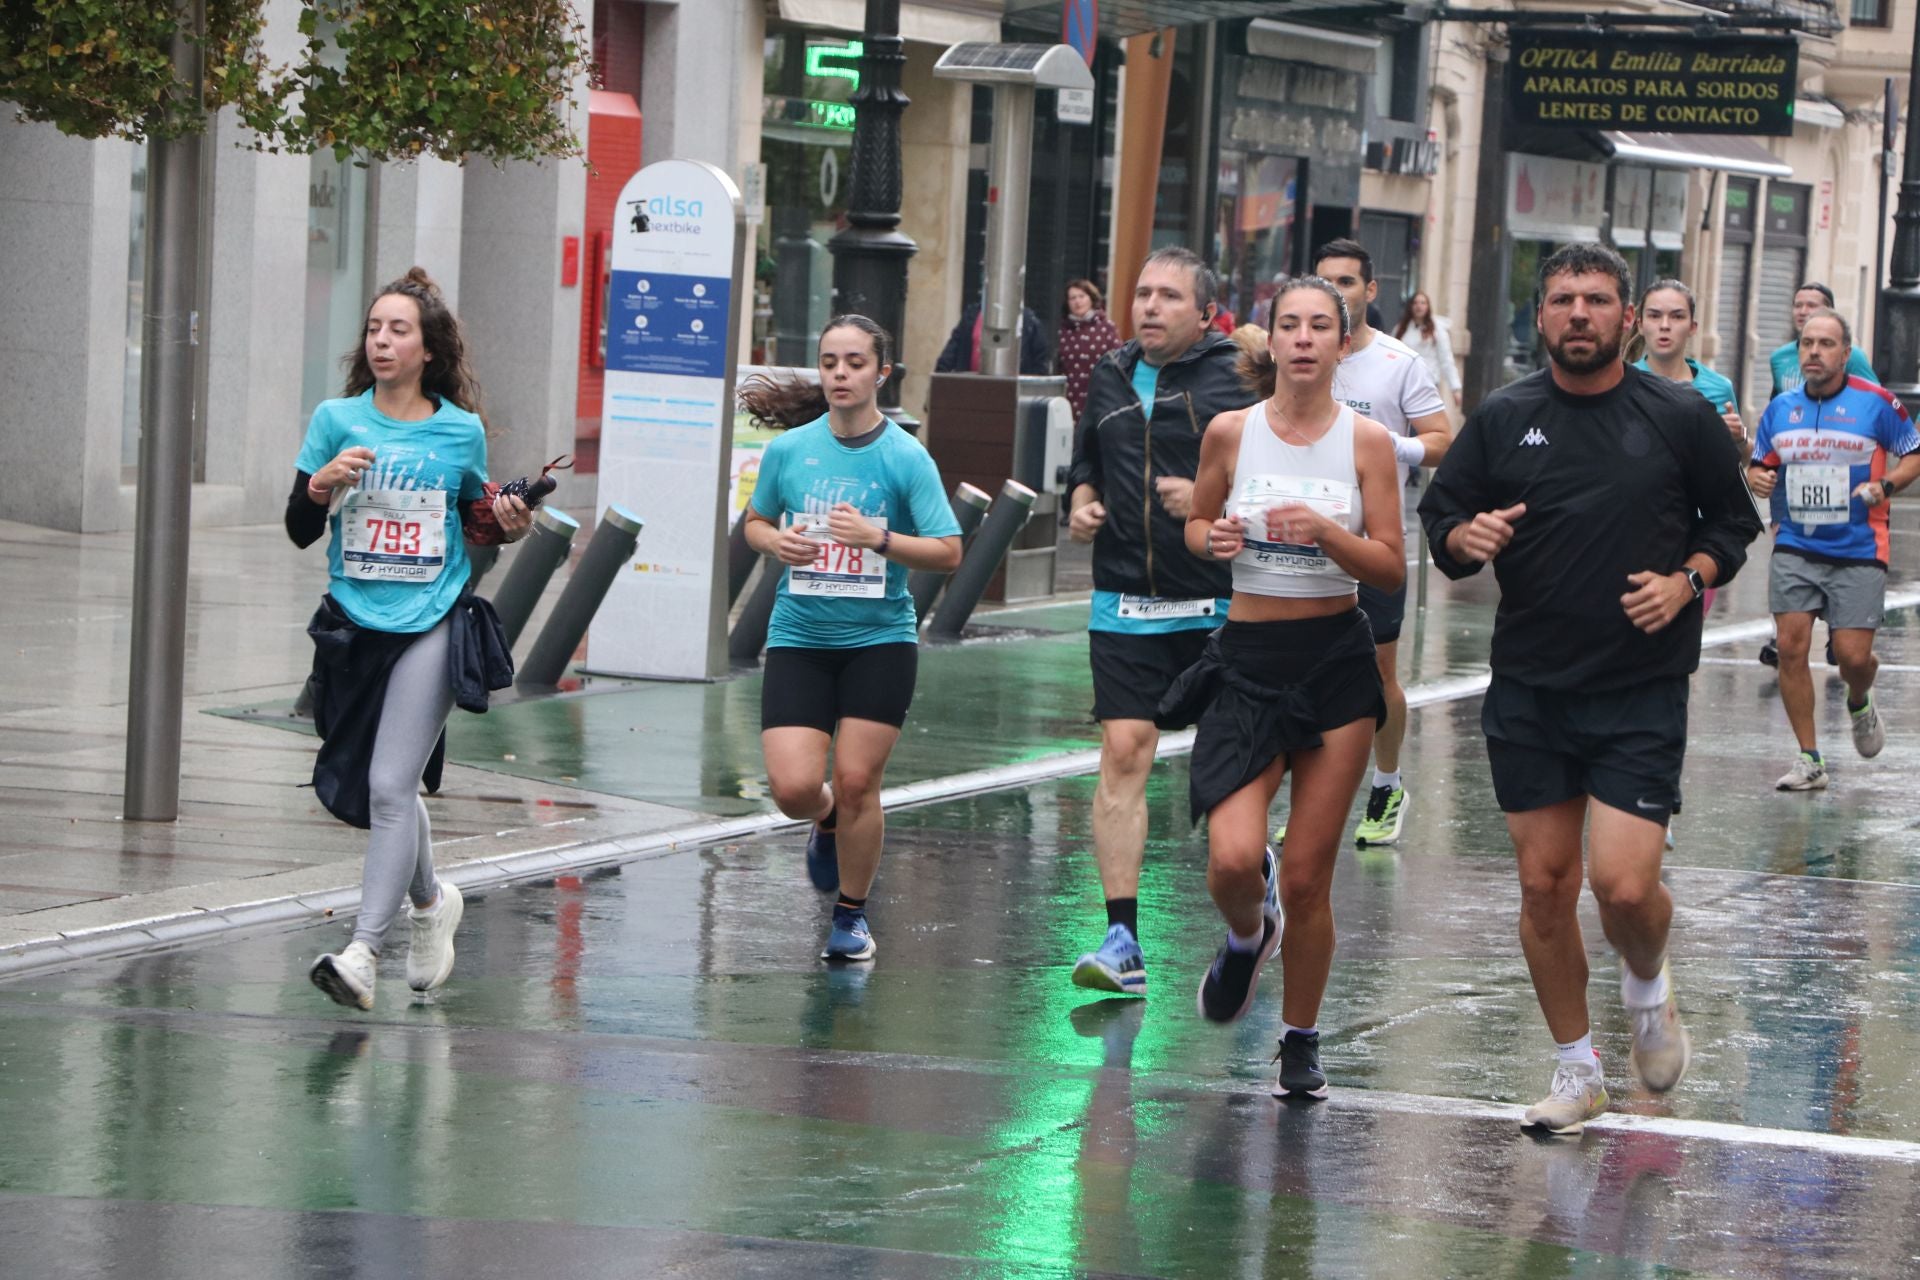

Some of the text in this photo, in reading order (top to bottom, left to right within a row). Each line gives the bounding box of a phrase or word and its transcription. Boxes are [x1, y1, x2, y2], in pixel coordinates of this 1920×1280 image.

[1519, 48, 1786, 74] OPTICA Emilia Barriada
[1523, 76, 1779, 100] APARATOS PARA SORDOS
[1539, 102, 1760, 124] LENTES DE CONTACTO
[648, 194, 703, 218] alsa
[1802, 485, 1830, 506] 681
[366, 518, 421, 554] 793
[378, 566, 427, 575] HYUNDAI
[1275, 555, 1327, 566] HYUNDAI
